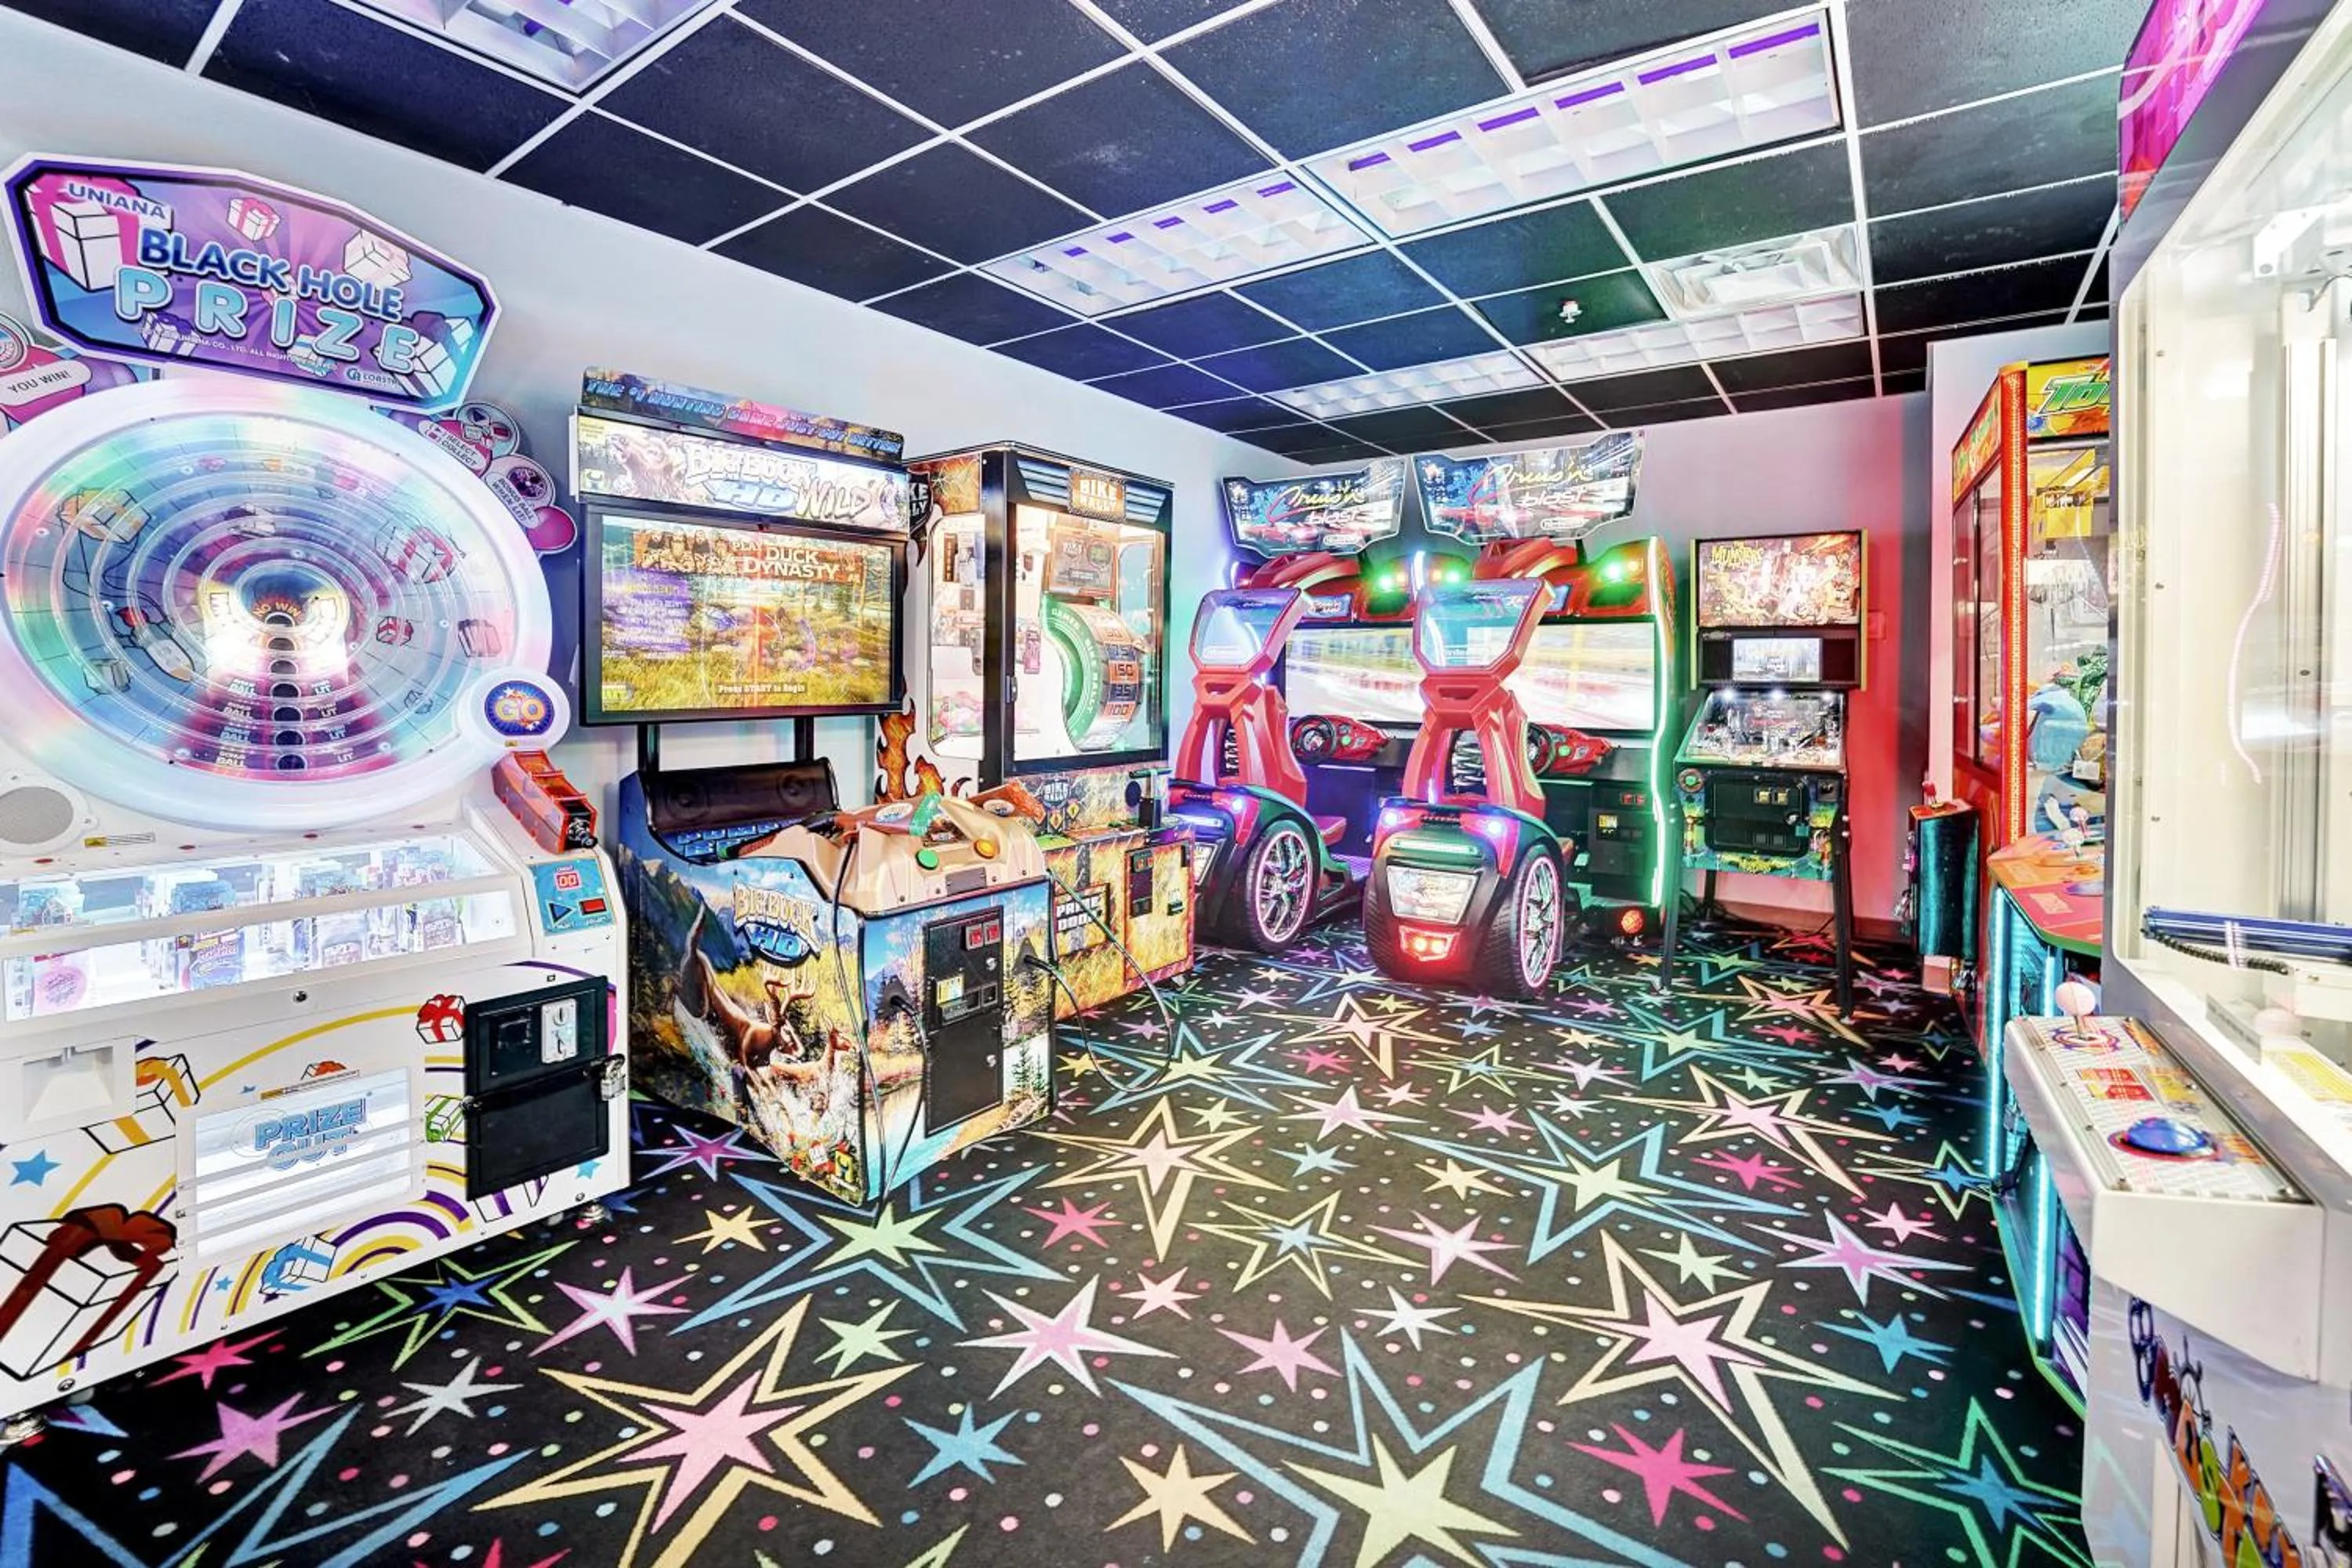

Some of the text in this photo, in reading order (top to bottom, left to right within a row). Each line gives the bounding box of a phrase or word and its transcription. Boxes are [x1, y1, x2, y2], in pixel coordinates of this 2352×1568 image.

[68, 183, 165, 220] UNIANA
[138, 227, 404, 322] BLACK HOLE
[115, 267, 419, 375] PRIZE
[8, 369, 71, 394] YOU WIN!
[441, 441, 478, 467] COLLECT
[795, 477, 873, 520] WILD
[1080, 479, 1117, 500] BIKE
[742, 556, 840, 580] DYNASTY
[765, 546, 819, 565] DUCK
[252, 601, 303, 619] NO WIN
[495, 698, 546, 722] GO
[215, 756, 246, 767] BALL
[750, 925, 802, 958] HD
[254, 1098, 366, 1151] PRIZE
